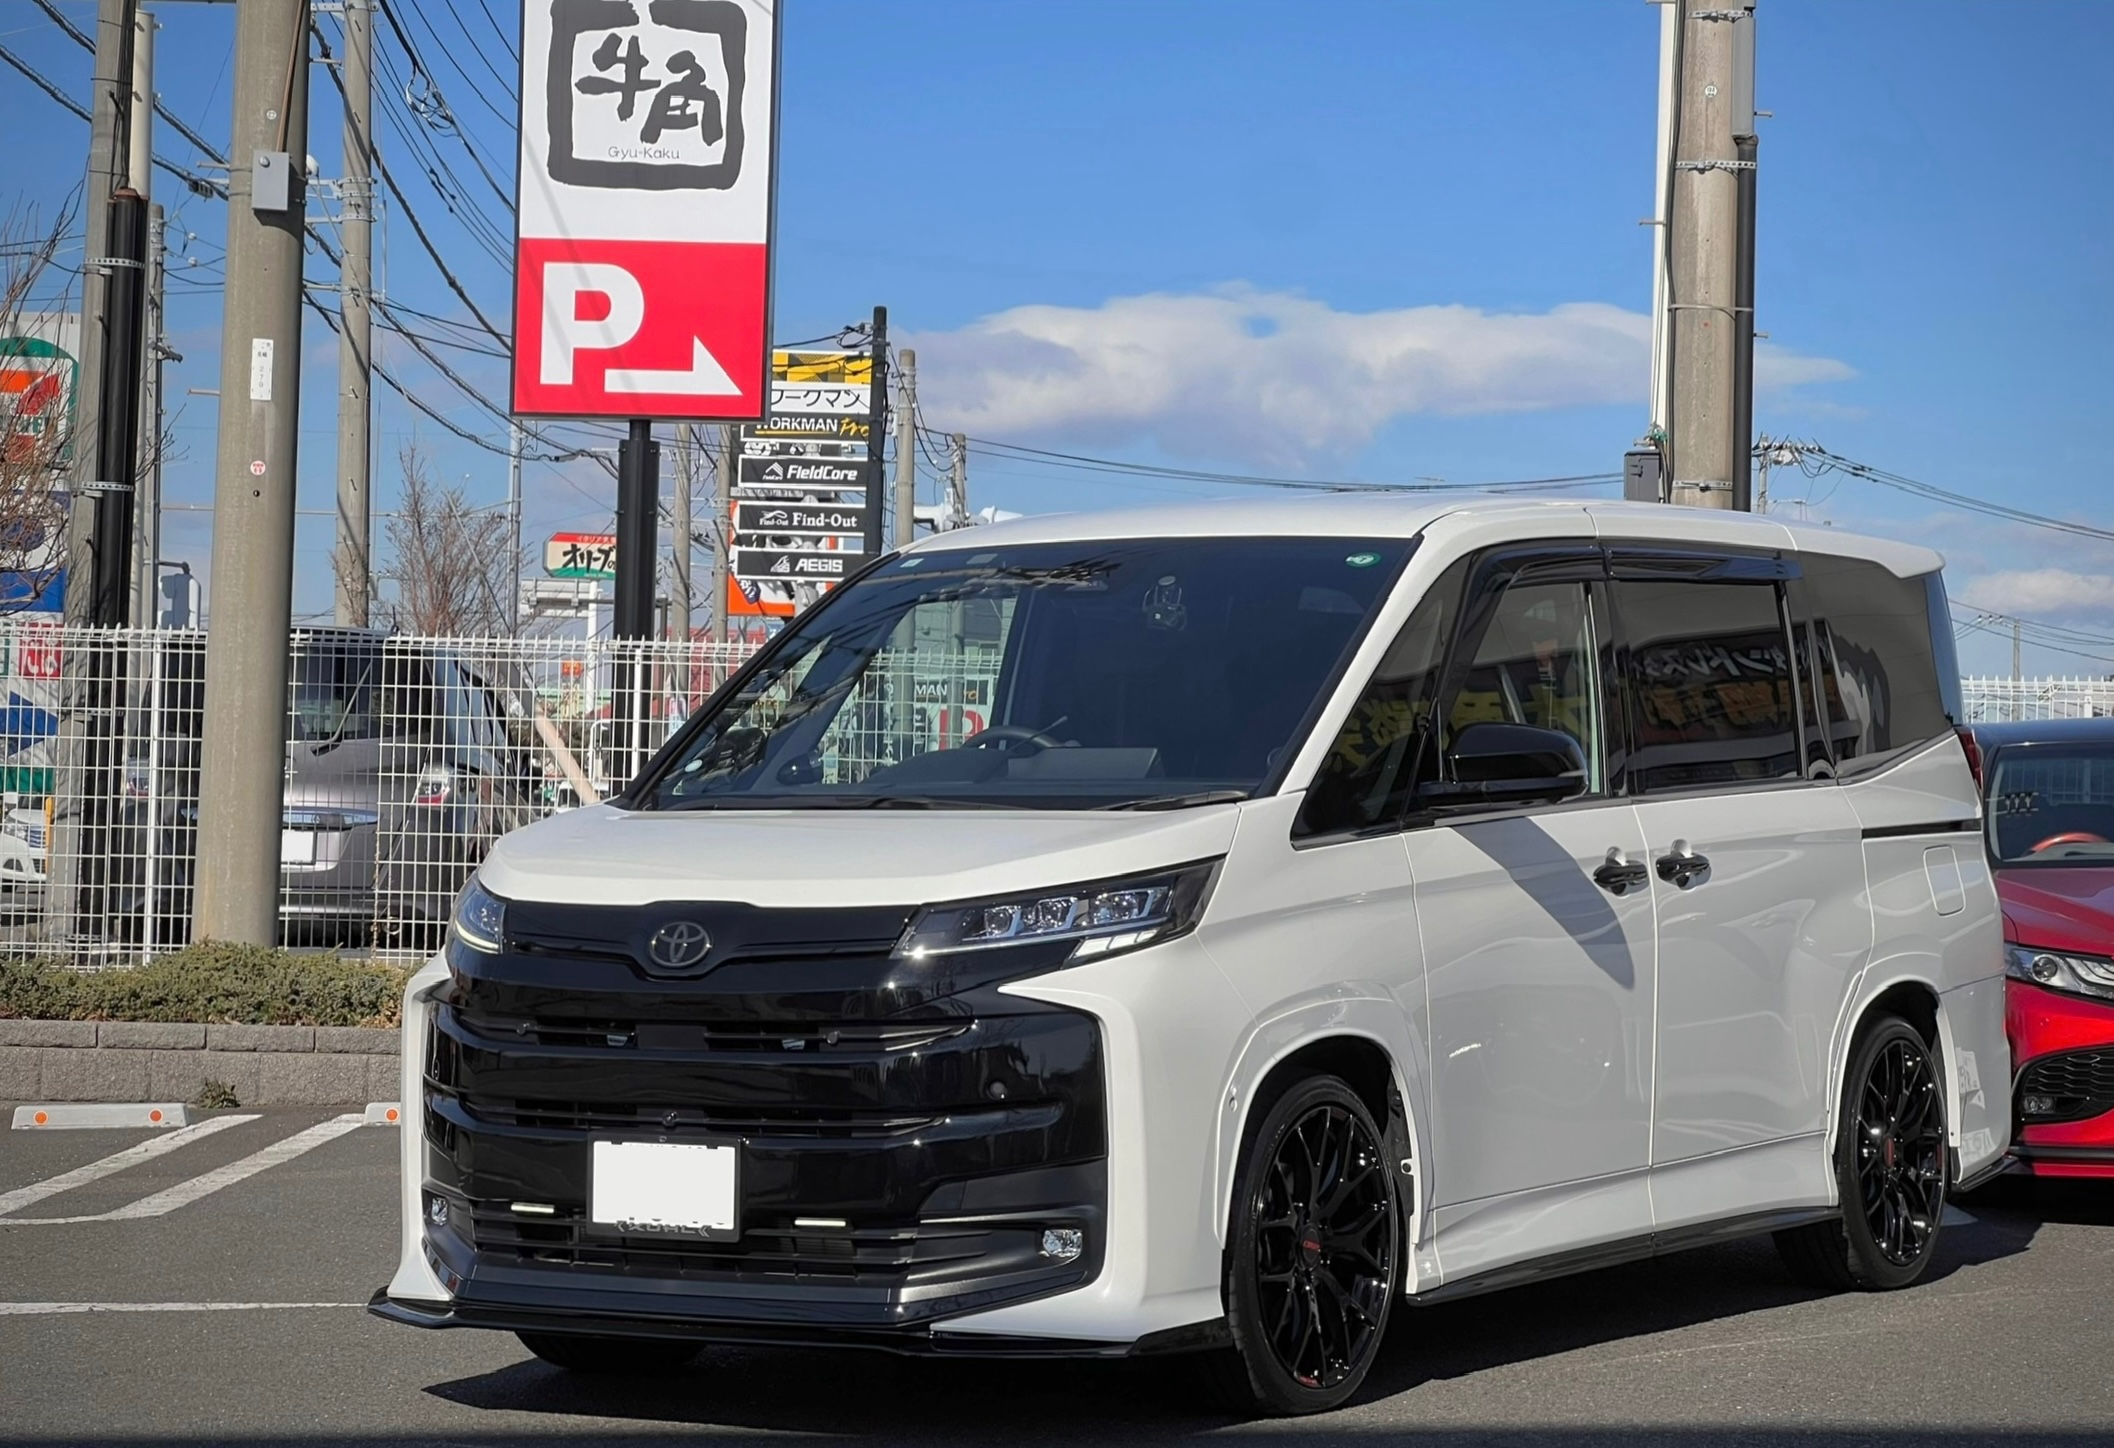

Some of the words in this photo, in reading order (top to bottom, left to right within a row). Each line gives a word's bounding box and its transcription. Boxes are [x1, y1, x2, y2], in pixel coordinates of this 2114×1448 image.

[574, 32, 724, 146] 牛角
[608, 146, 680, 161] Gyu-Kaku
[539, 261, 645, 386] P
[757, 417, 838, 432] ORKMAN
[787, 464, 858, 481] FieldCore
[792, 512, 858, 528] Find-Out
[795, 558, 843, 573] AEGIS
